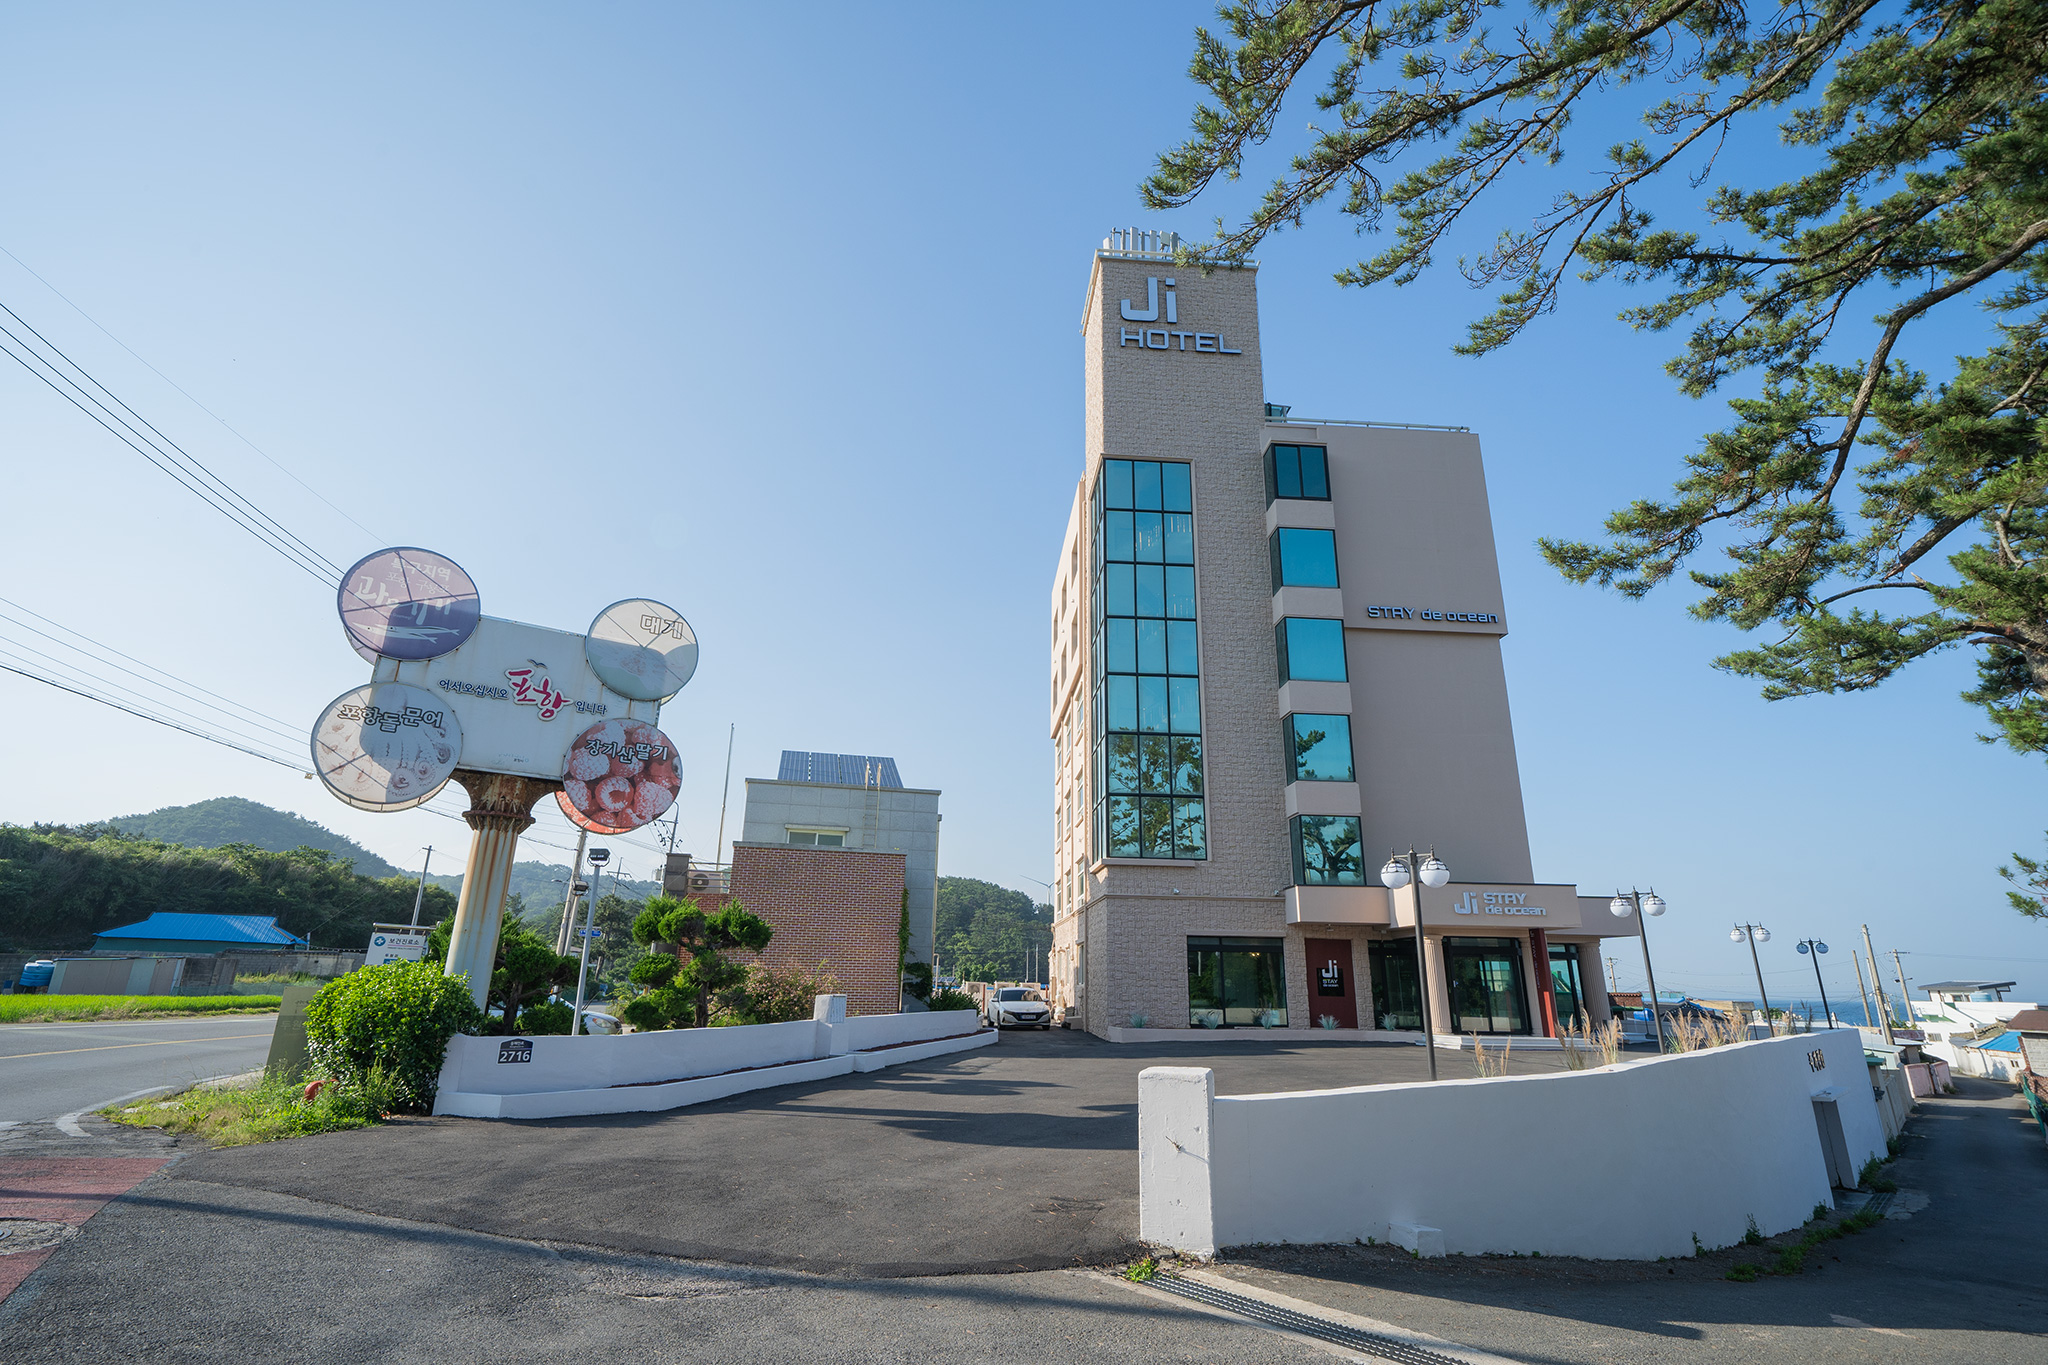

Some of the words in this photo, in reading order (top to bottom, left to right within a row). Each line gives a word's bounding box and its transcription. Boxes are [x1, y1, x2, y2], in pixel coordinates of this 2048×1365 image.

[1120, 276, 1178, 324] Ji
[1120, 327, 1242, 354] HOTEL
[1367, 605, 1415, 619] STAY
[1420, 608, 1443, 621] de
[1446, 611, 1499, 624] ocean
[640, 614, 684, 640] 대게
[438, 679, 508, 700] 어서오십시오
[505, 668, 573, 720] 포항
[575, 700, 607, 715] 입니다
[337, 704, 443, 733] 포항돌문어
[585, 739, 669, 764] 장기산딸기
[1454, 892, 1479, 914] Ji
[1483, 892, 1527, 904] STAY
[1485, 904, 1503, 915] de
[1504, 906, 1547, 916] ocean
[1321, 959, 1338, 978] Ji
[500, 1051, 530, 1062] 2716
